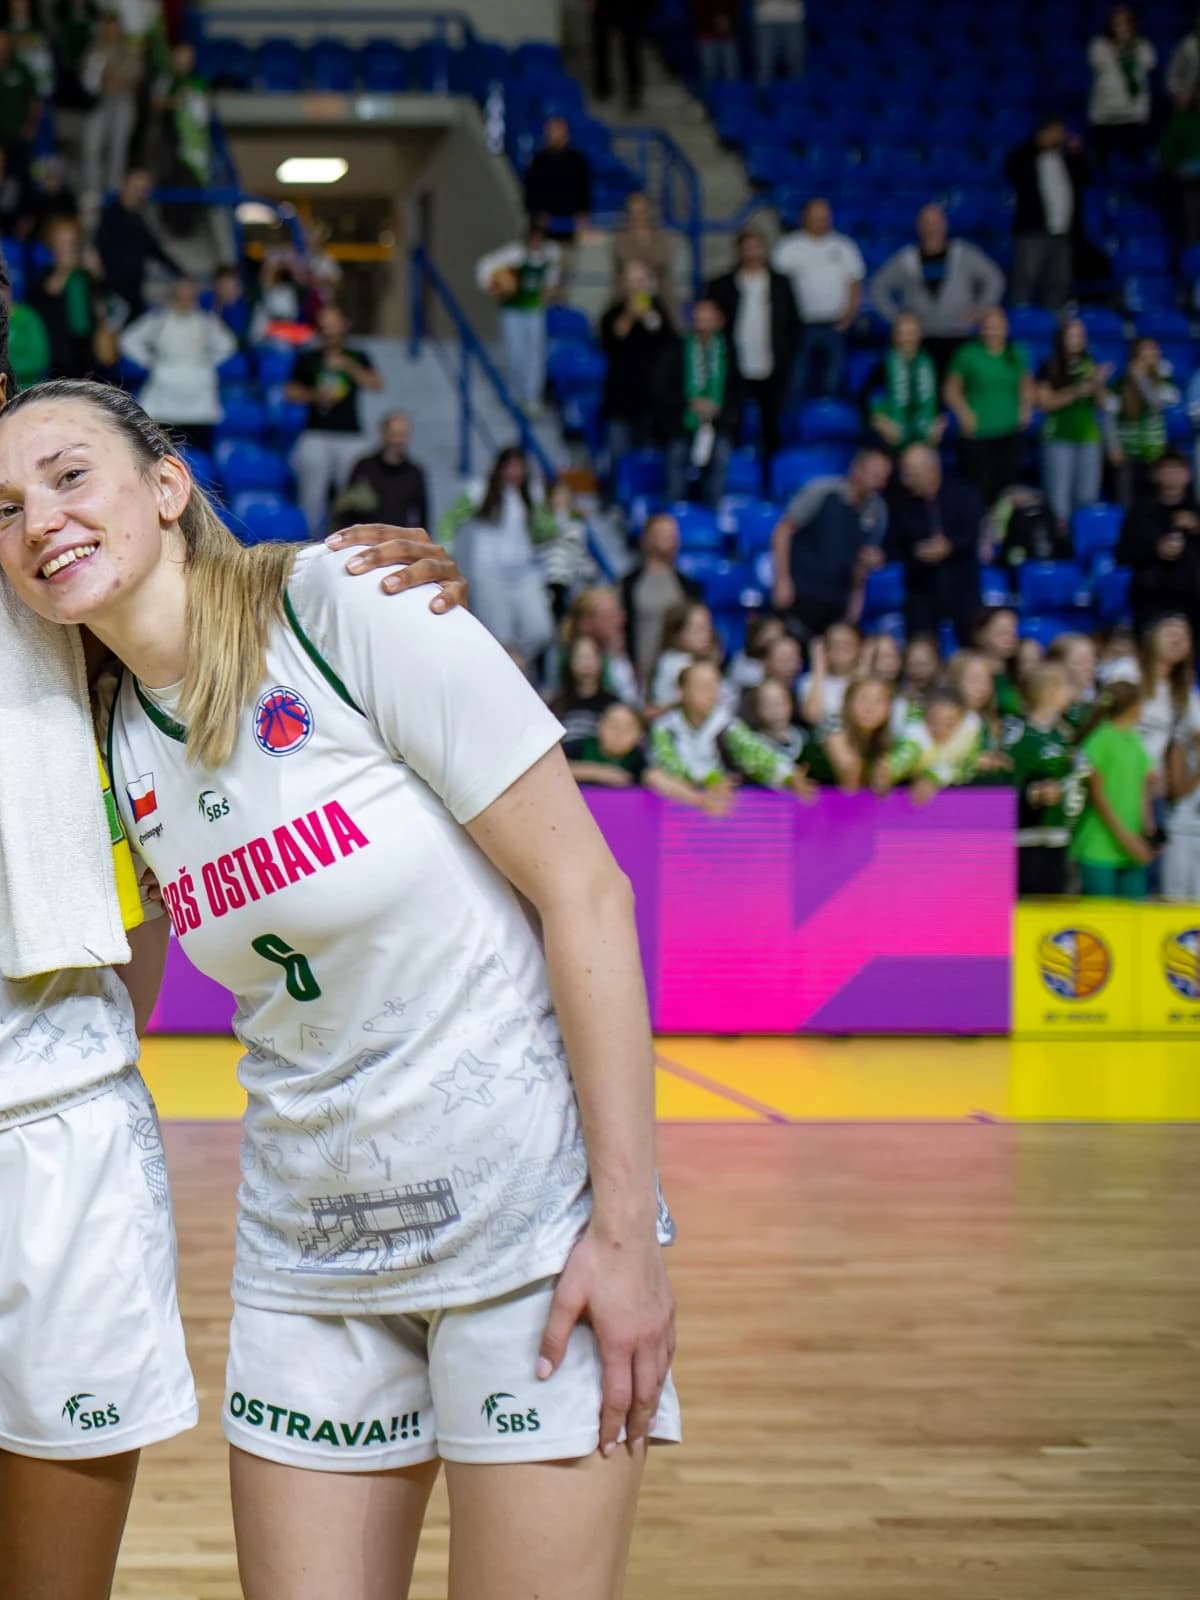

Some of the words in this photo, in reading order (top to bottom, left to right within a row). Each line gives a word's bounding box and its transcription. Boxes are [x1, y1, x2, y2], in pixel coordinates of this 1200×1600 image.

[206, 797, 230, 823] SBŠ
[201, 800, 371, 918] OSTRAVA
[79, 1403, 121, 1431] SBŠ
[229, 1391, 421, 1447] OSTRAVA!!!
[495, 1408, 541, 1434] SBŠ
